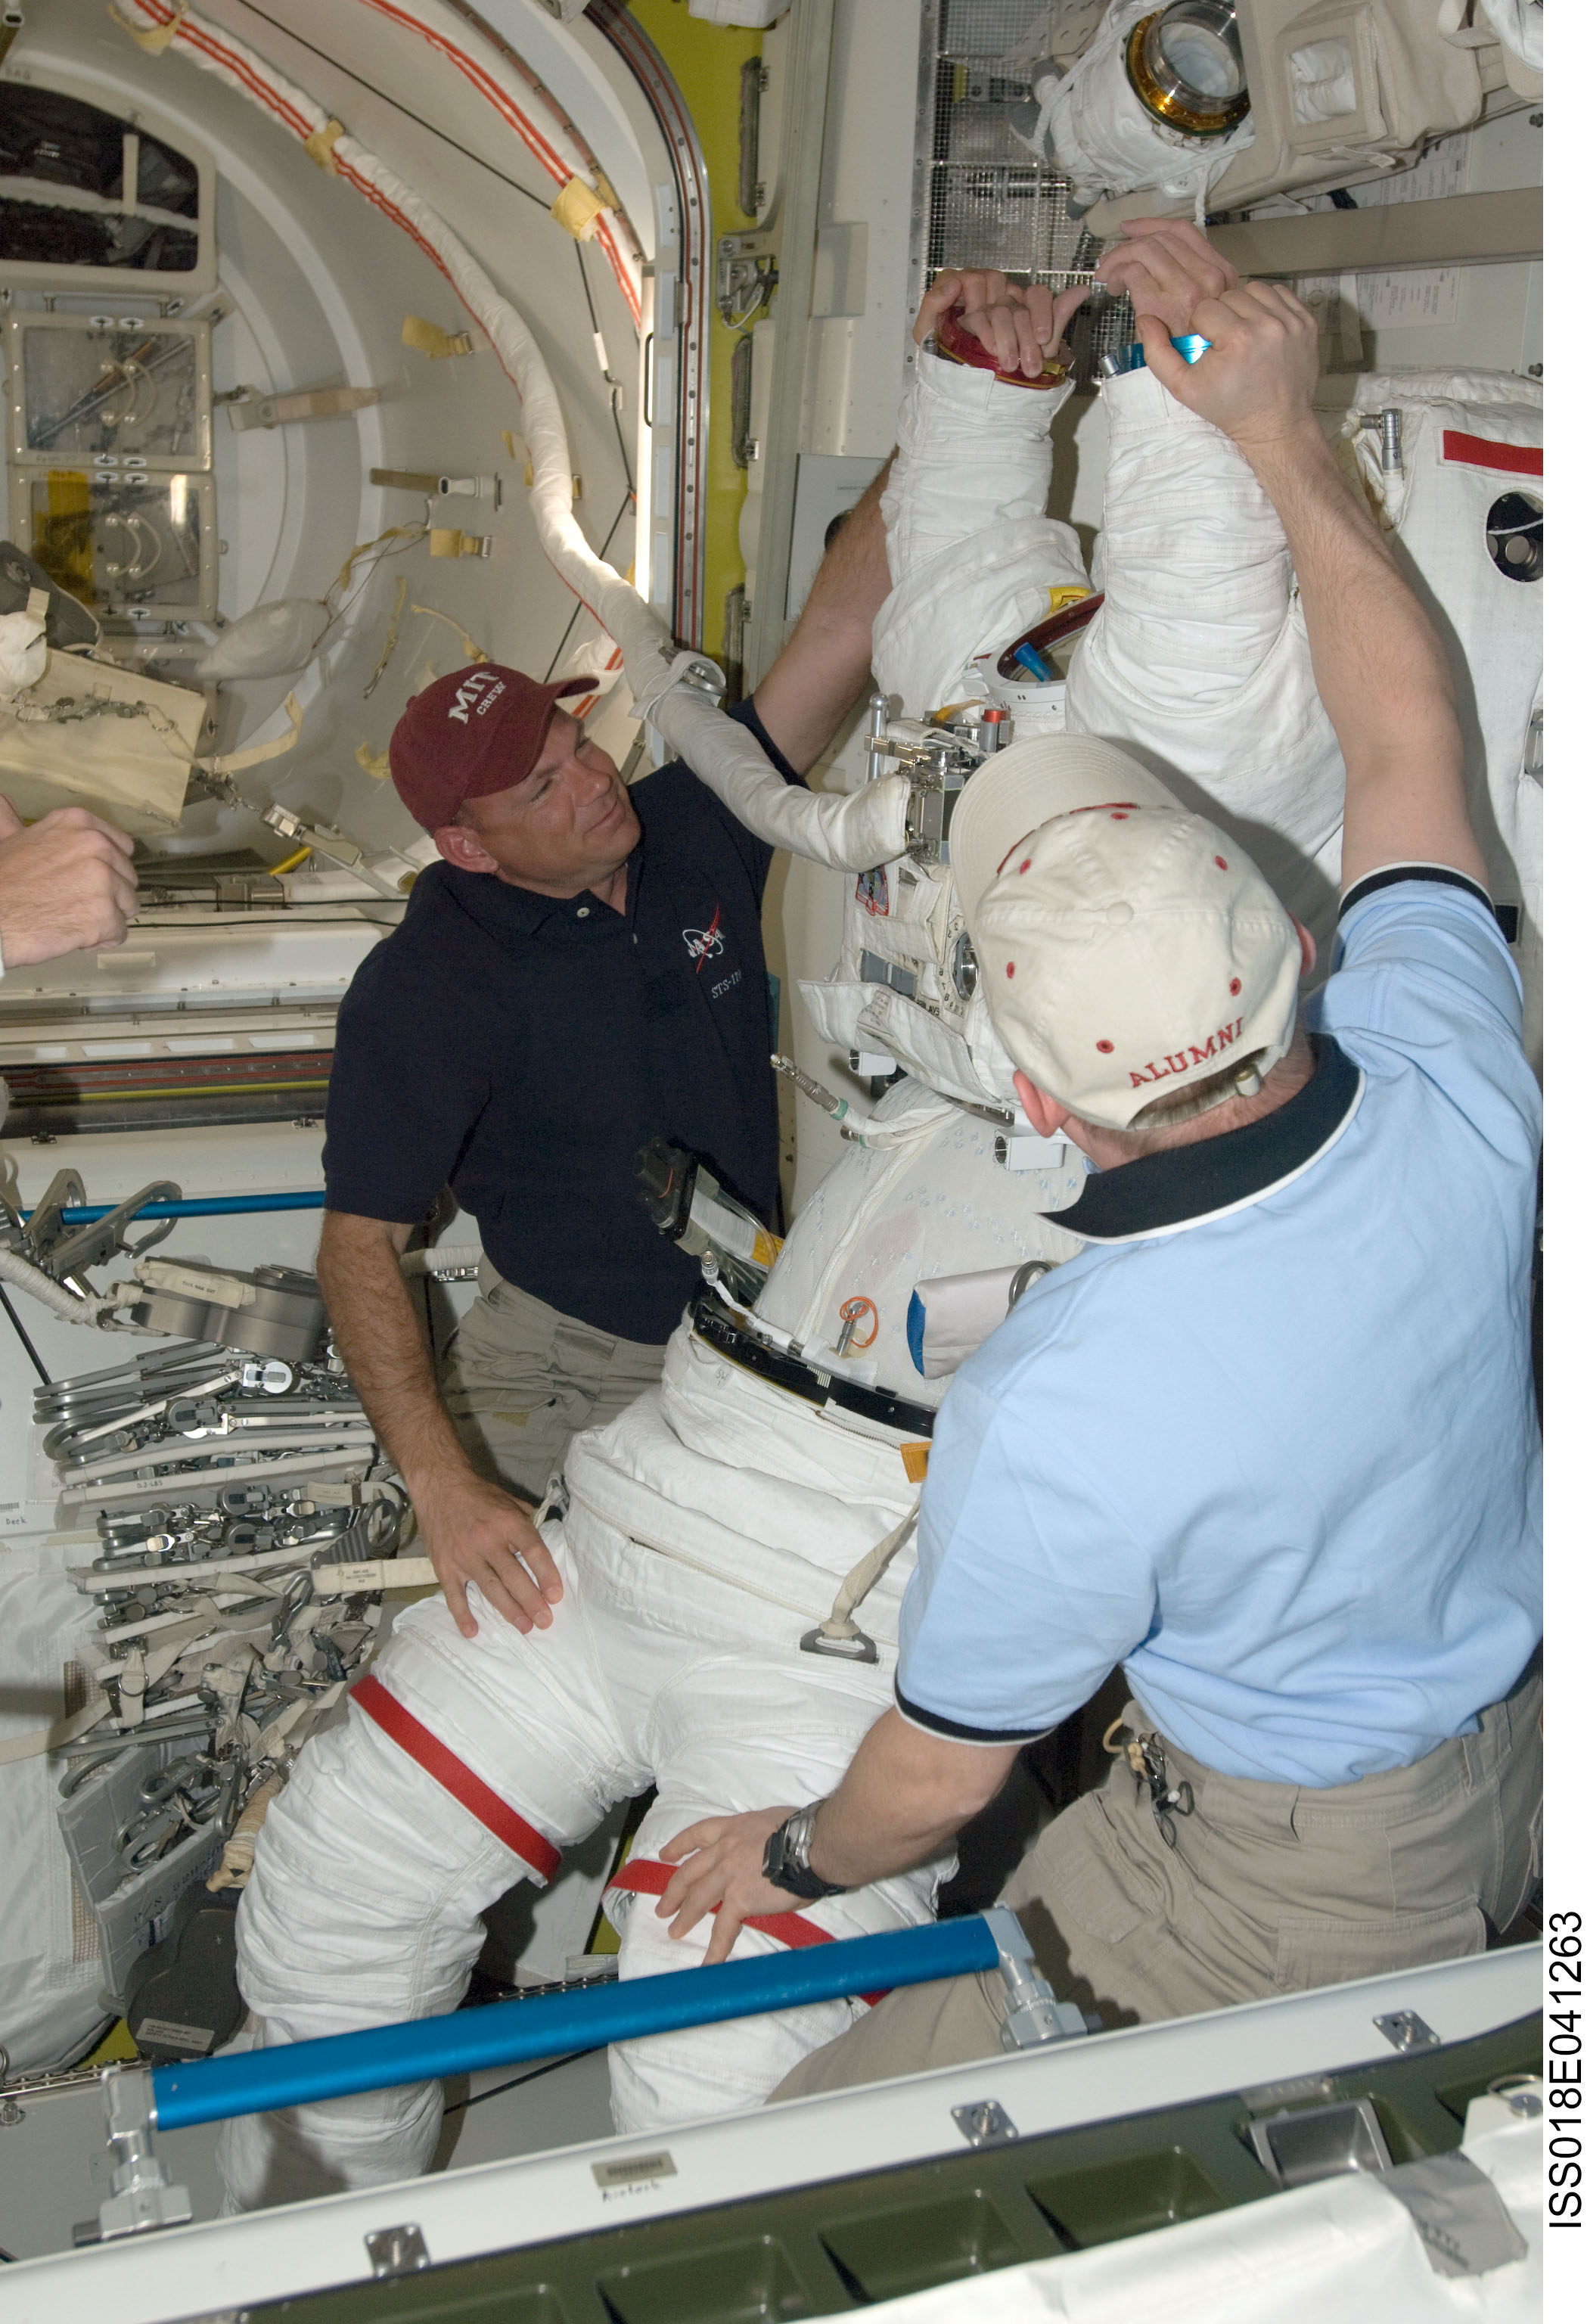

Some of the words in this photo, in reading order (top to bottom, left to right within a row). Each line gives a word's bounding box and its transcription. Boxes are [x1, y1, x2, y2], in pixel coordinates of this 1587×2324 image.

[448, 671, 500, 724] MIT
[476, 681, 507, 716] CREW
[688, 927, 726, 958] NASA
[1129, 1016, 1244, 1089] ALUMNI
[5, 1517, 27, 1526] Deck
